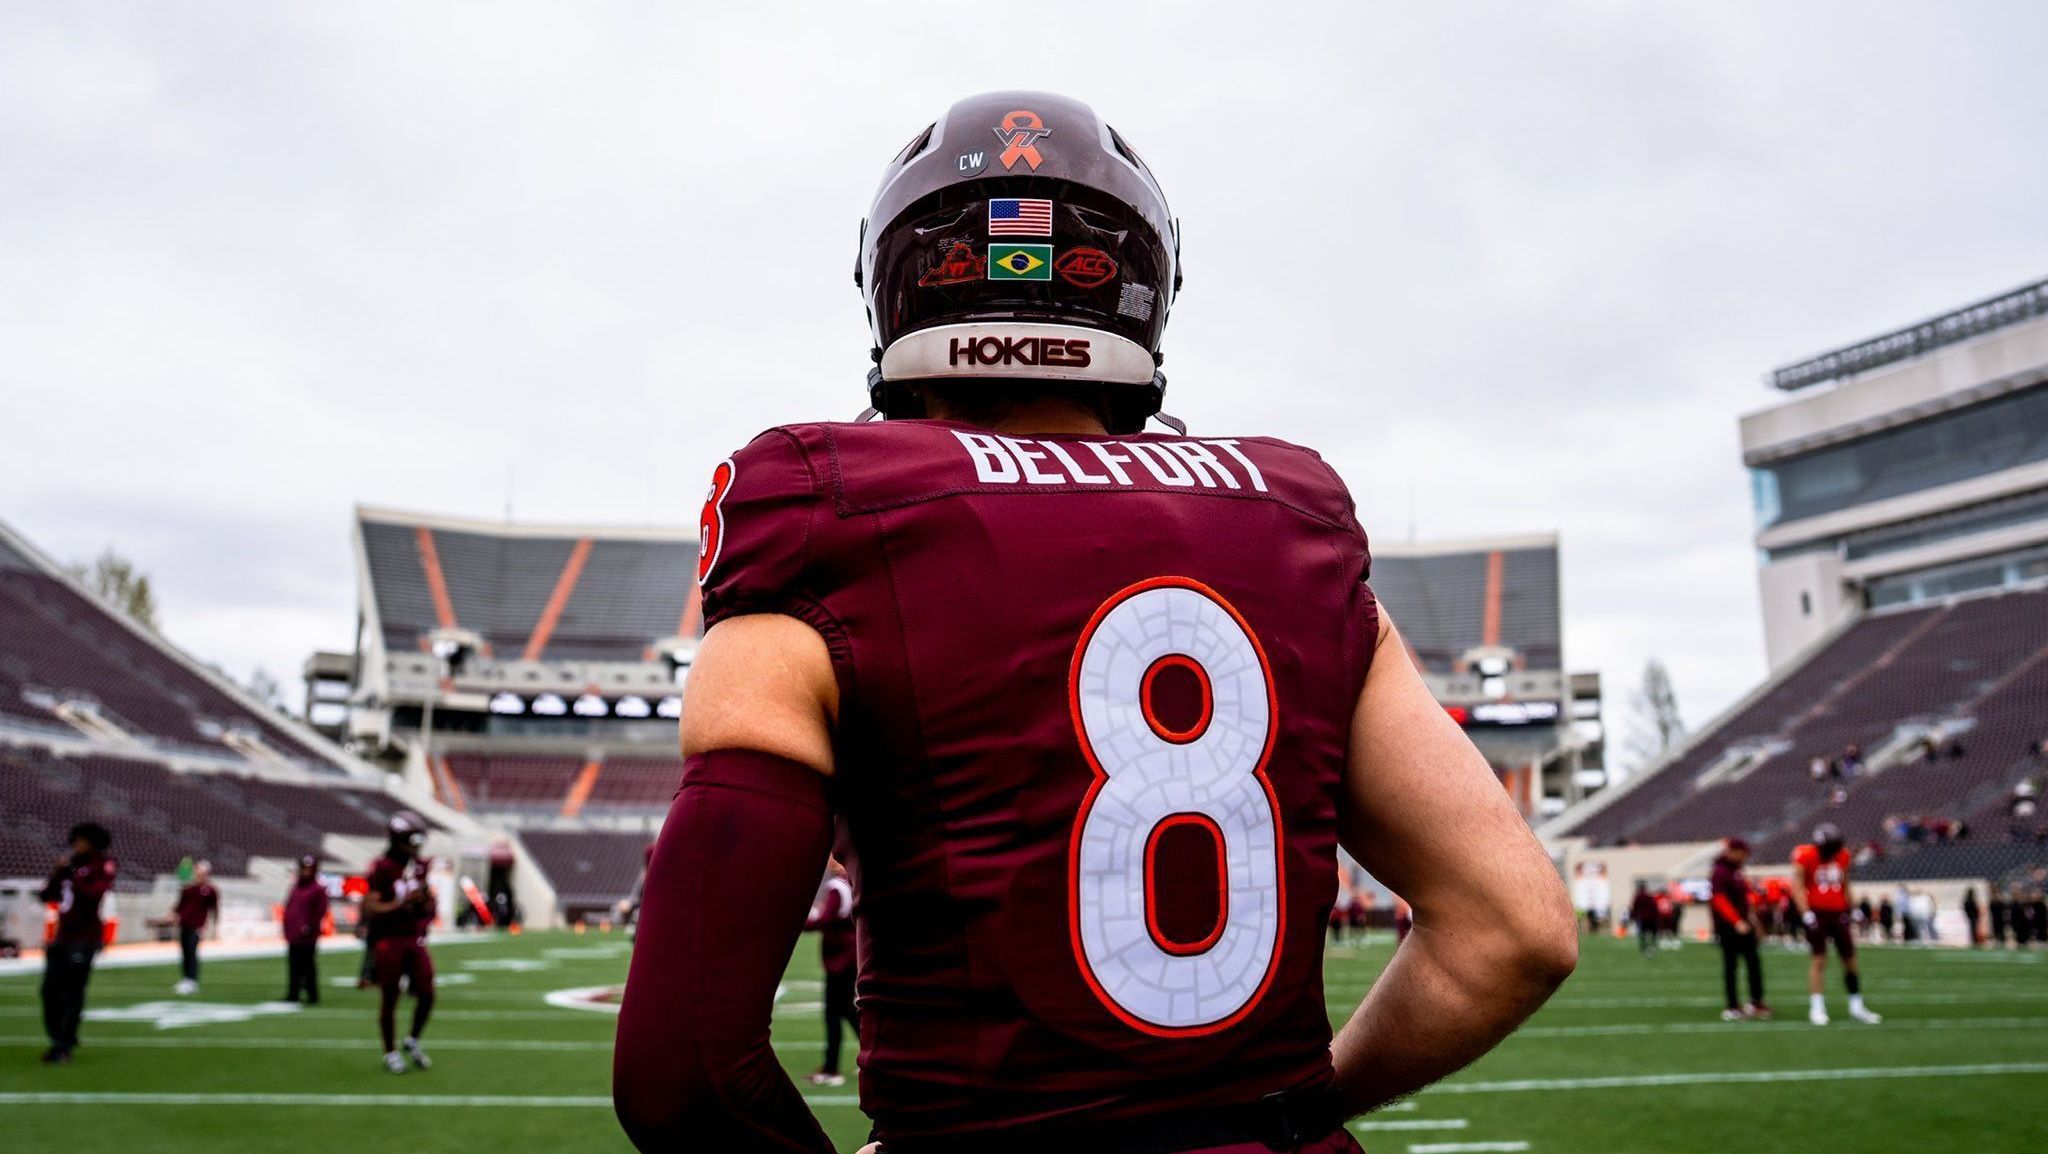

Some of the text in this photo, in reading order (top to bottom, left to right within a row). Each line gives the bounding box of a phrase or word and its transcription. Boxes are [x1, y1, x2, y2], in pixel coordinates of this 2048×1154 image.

[959, 151, 984, 171] CW
[1062, 256, 1107, 273] ACC
[949, 336, 1091, 368] HOKIES
[950, 429, 1268, 492] BELFORT
[698, 458, 736, 586] 8
[1068, 575, 1287, 1039] 8
